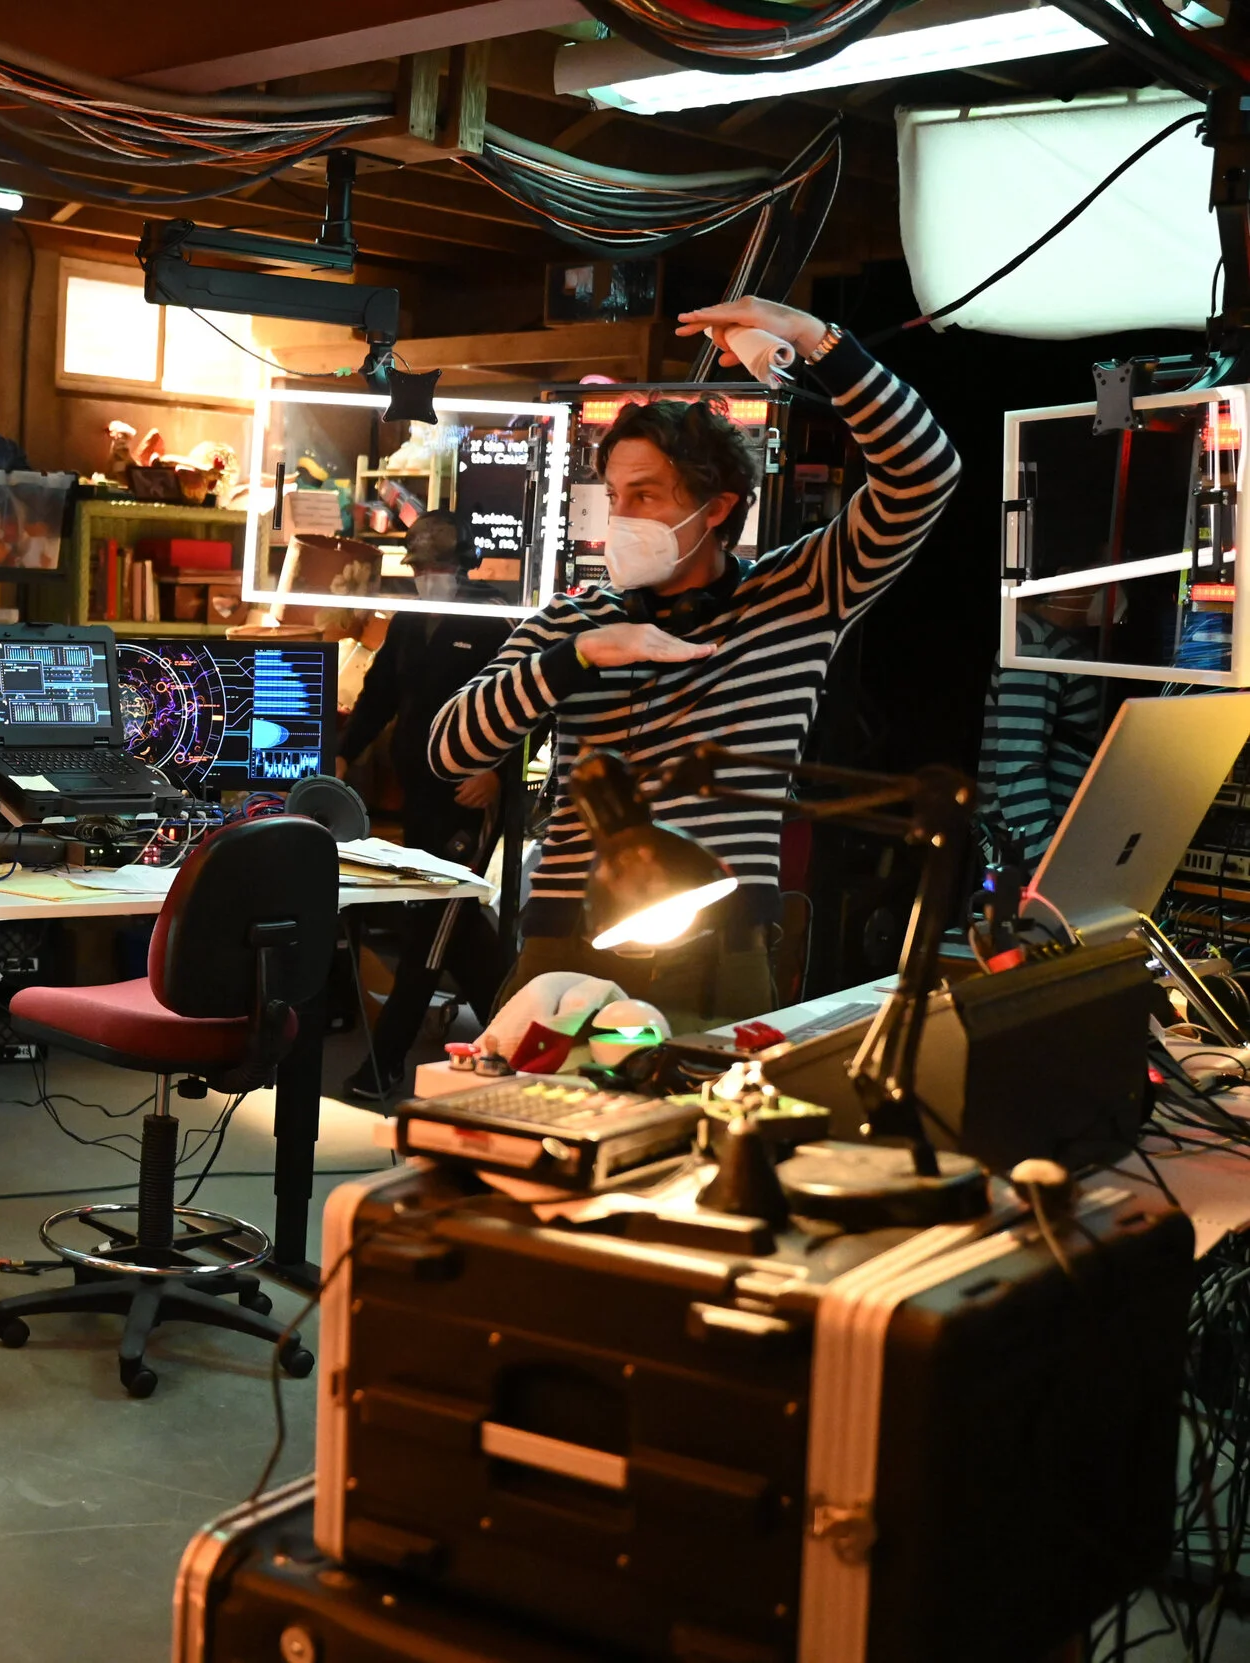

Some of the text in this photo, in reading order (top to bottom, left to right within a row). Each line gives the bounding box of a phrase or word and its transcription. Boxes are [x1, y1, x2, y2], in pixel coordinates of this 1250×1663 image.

[484, 440, 504, 452] the
[471, 452, 492, 463] the
[491, 527, 513, 538] you
